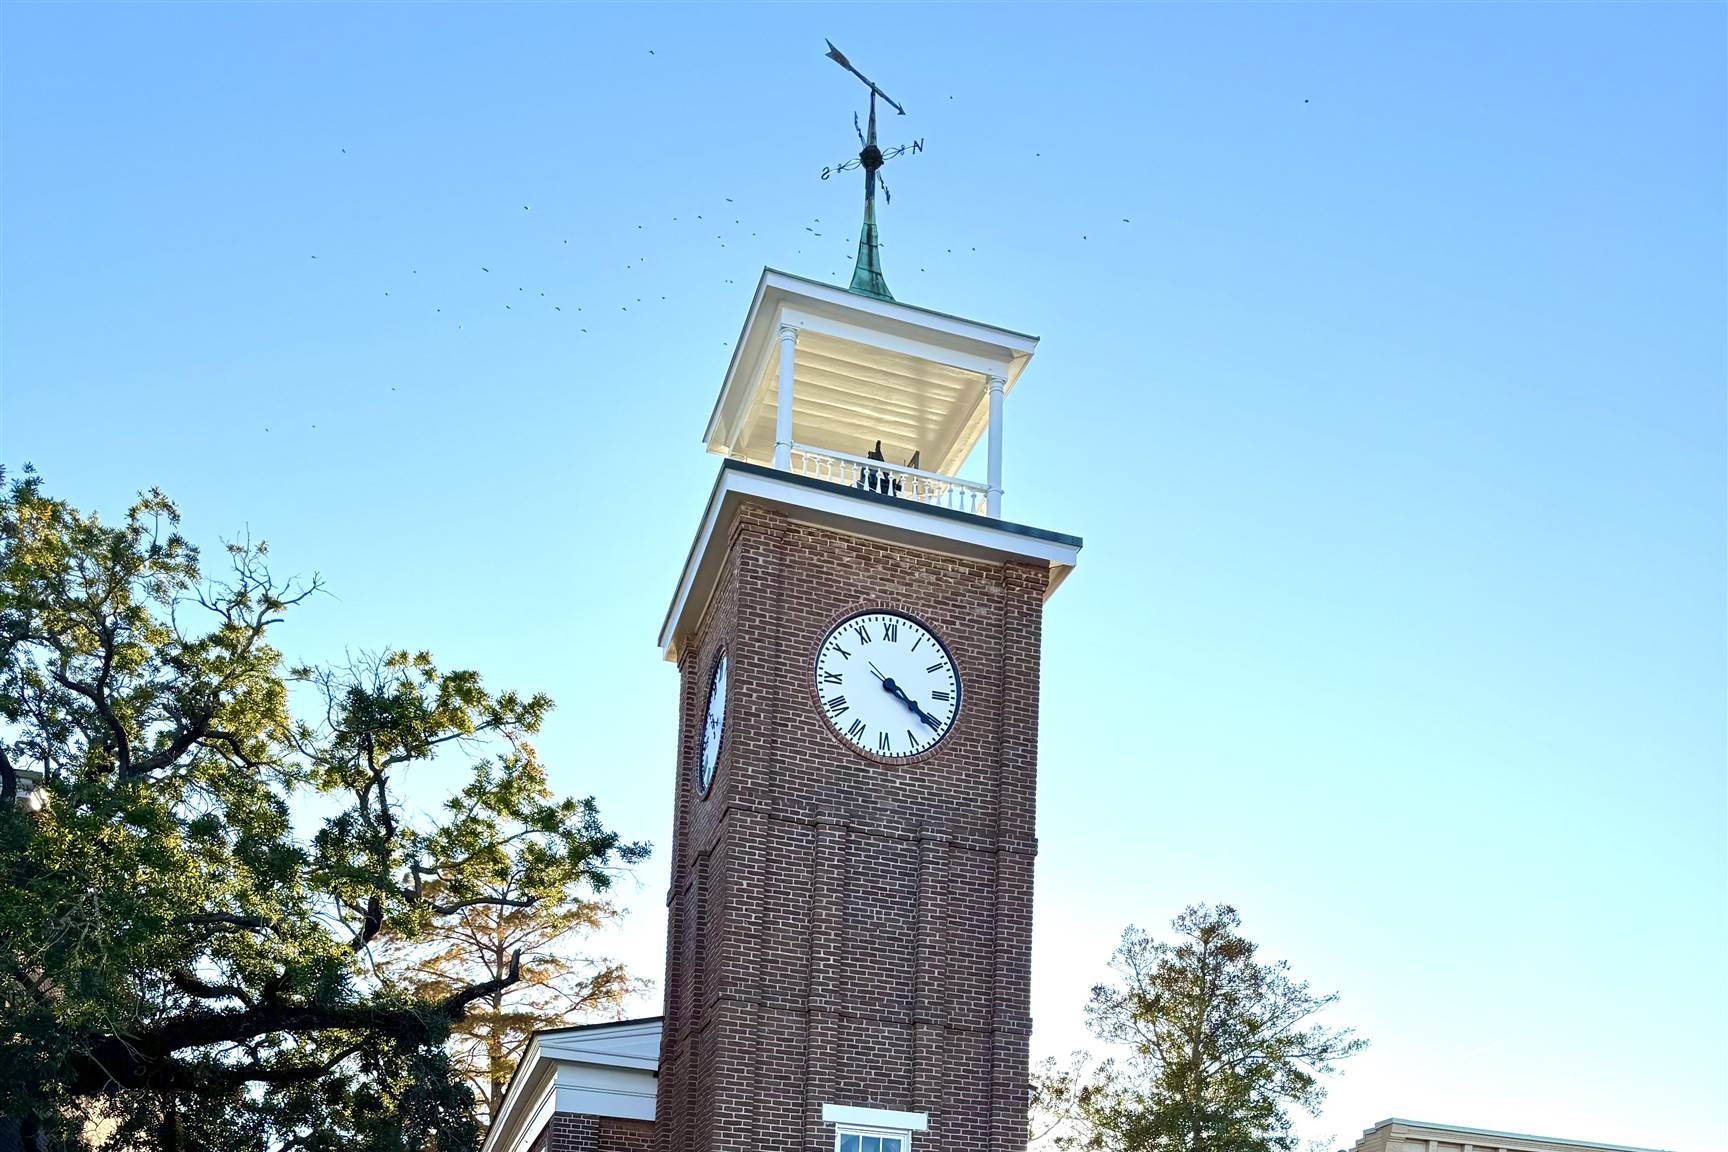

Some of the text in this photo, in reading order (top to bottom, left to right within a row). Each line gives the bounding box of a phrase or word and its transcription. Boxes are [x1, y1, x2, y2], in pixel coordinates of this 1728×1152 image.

[912, 138, 924, 155] N
[854, 624, 872, 646] XI
[883, 622, 898, 643] XII
[833, 643, 851, 660] X
